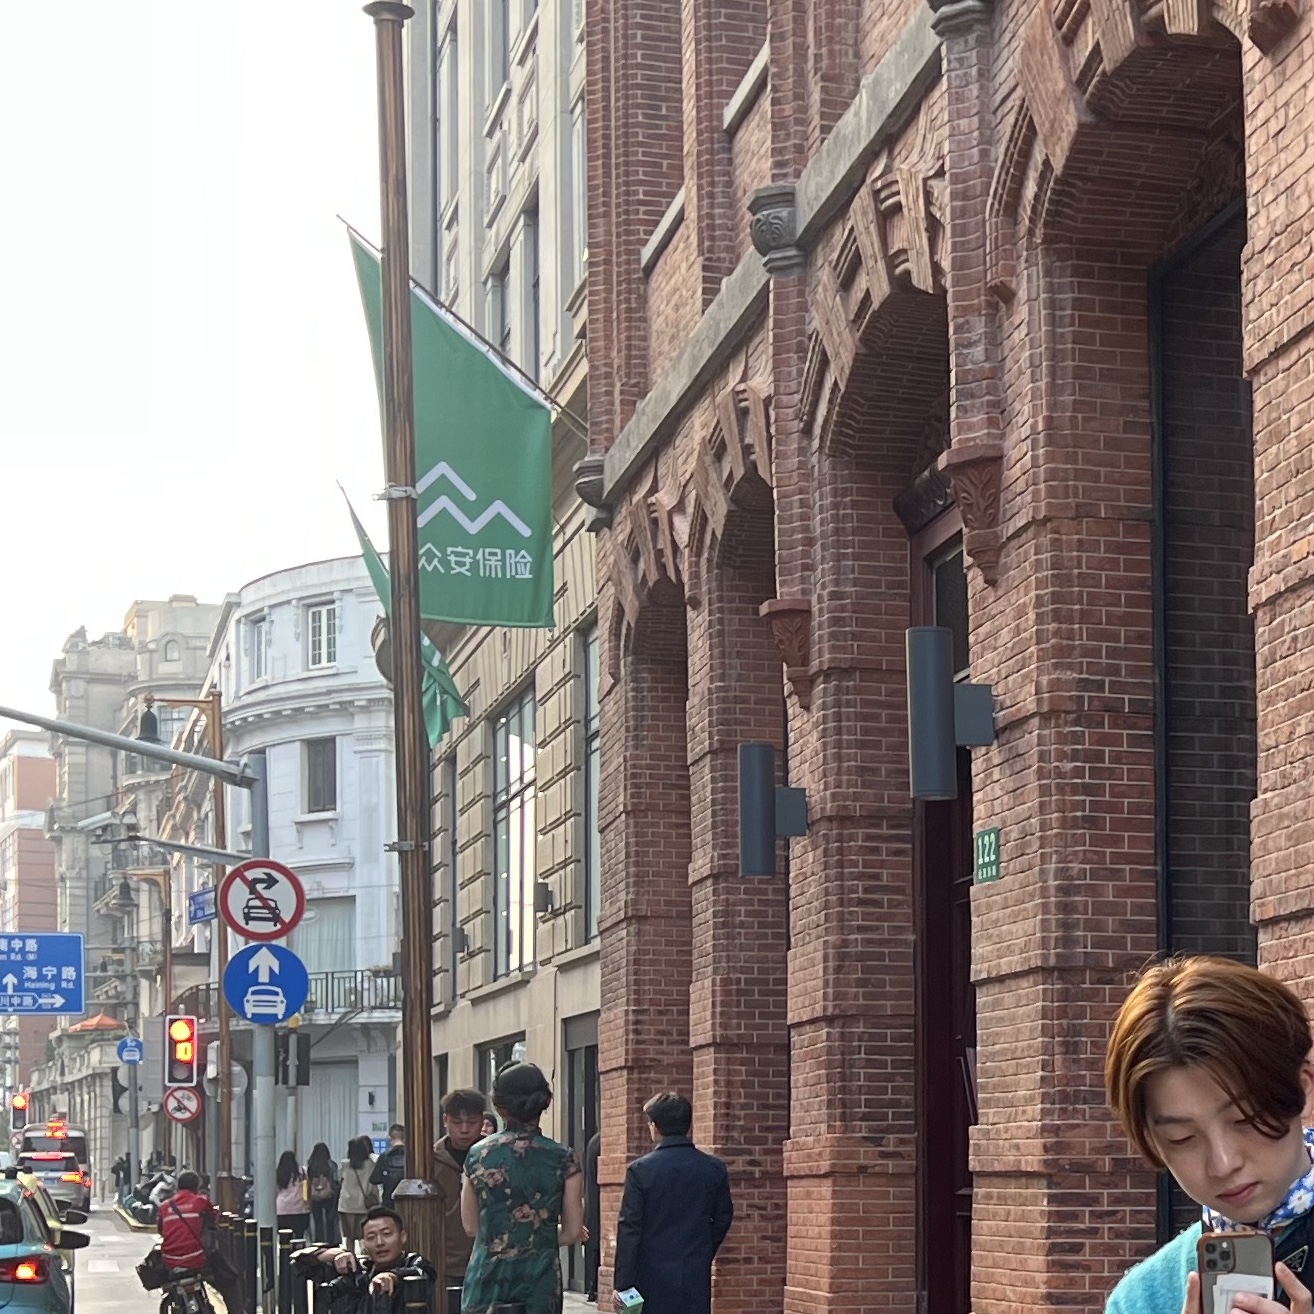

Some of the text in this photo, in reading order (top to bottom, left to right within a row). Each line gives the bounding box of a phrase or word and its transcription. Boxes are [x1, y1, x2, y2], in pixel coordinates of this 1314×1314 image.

[418, 542, 533, 579] 众安保险
[978, 832, 996, 865] 122
[22, 965, 77, 980] 海宁路
[24, 981, 56, 991] Haining
